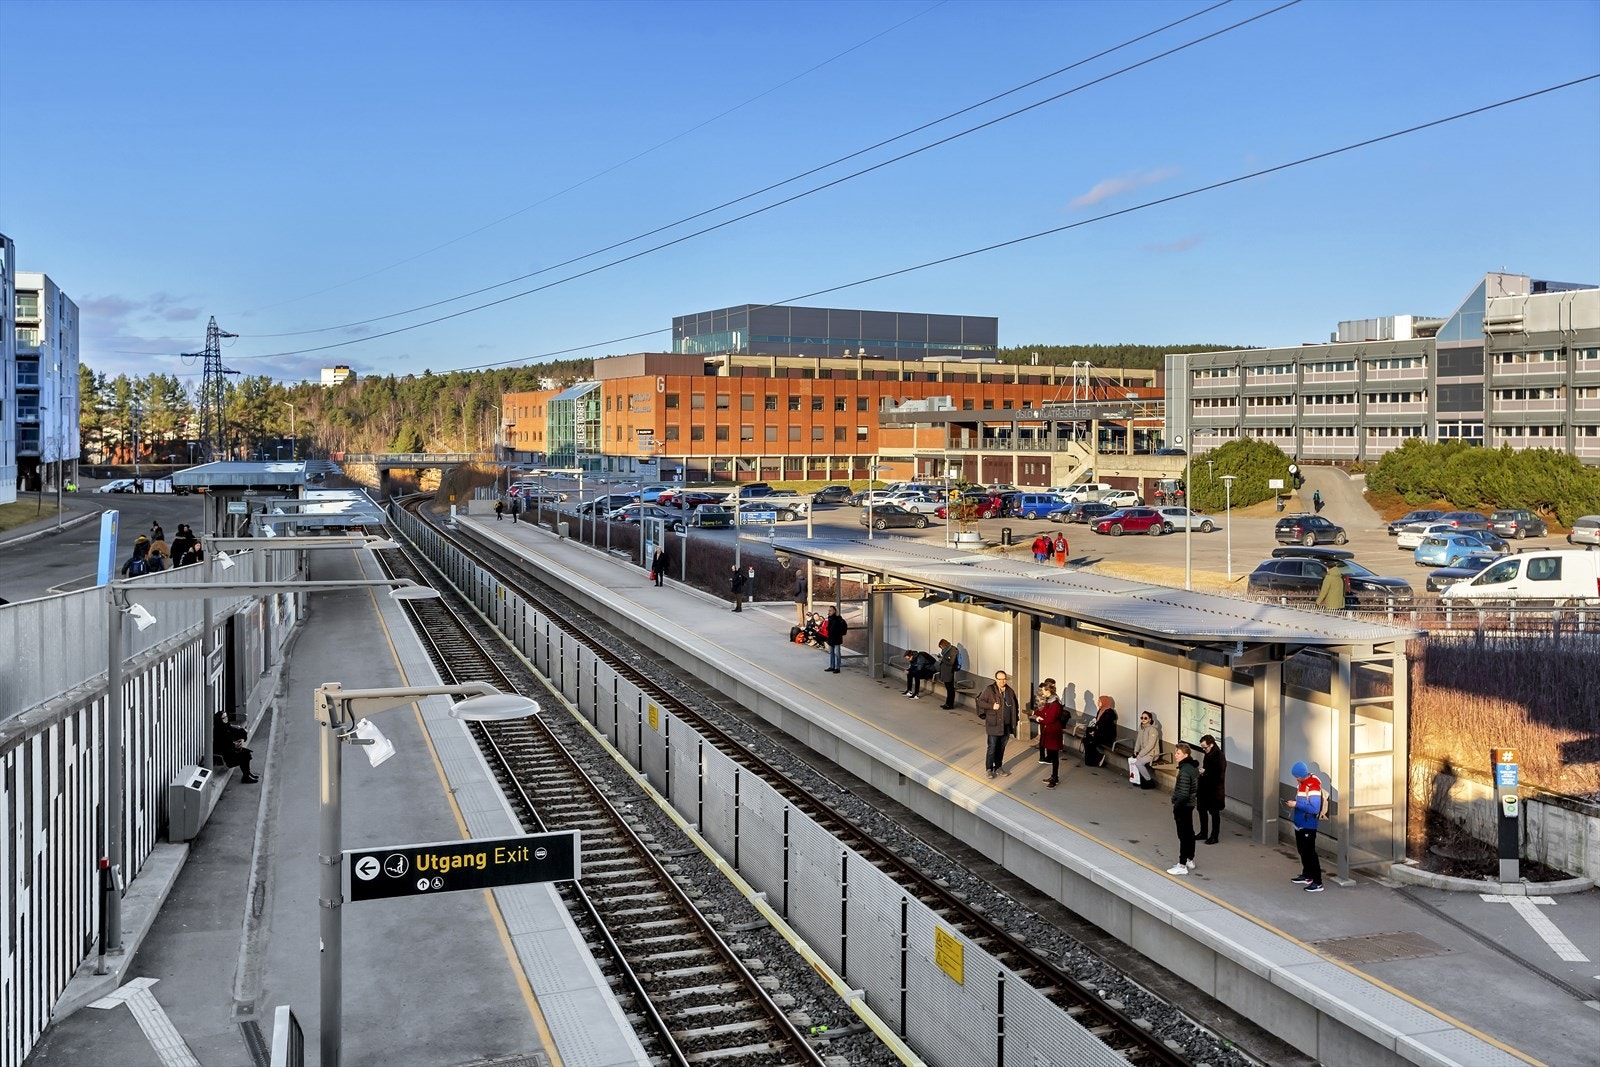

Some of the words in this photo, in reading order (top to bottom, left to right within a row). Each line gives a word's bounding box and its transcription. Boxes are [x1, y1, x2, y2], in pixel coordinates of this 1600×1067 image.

[657, 376, 665, 393] G
[1015, 410, 1033, 419] OSLO
[1040, 408, 1091, 419] KLATRESENTER
[416, 852, 487, 874] Utgang
[494, 845, 530, 864] Exit
